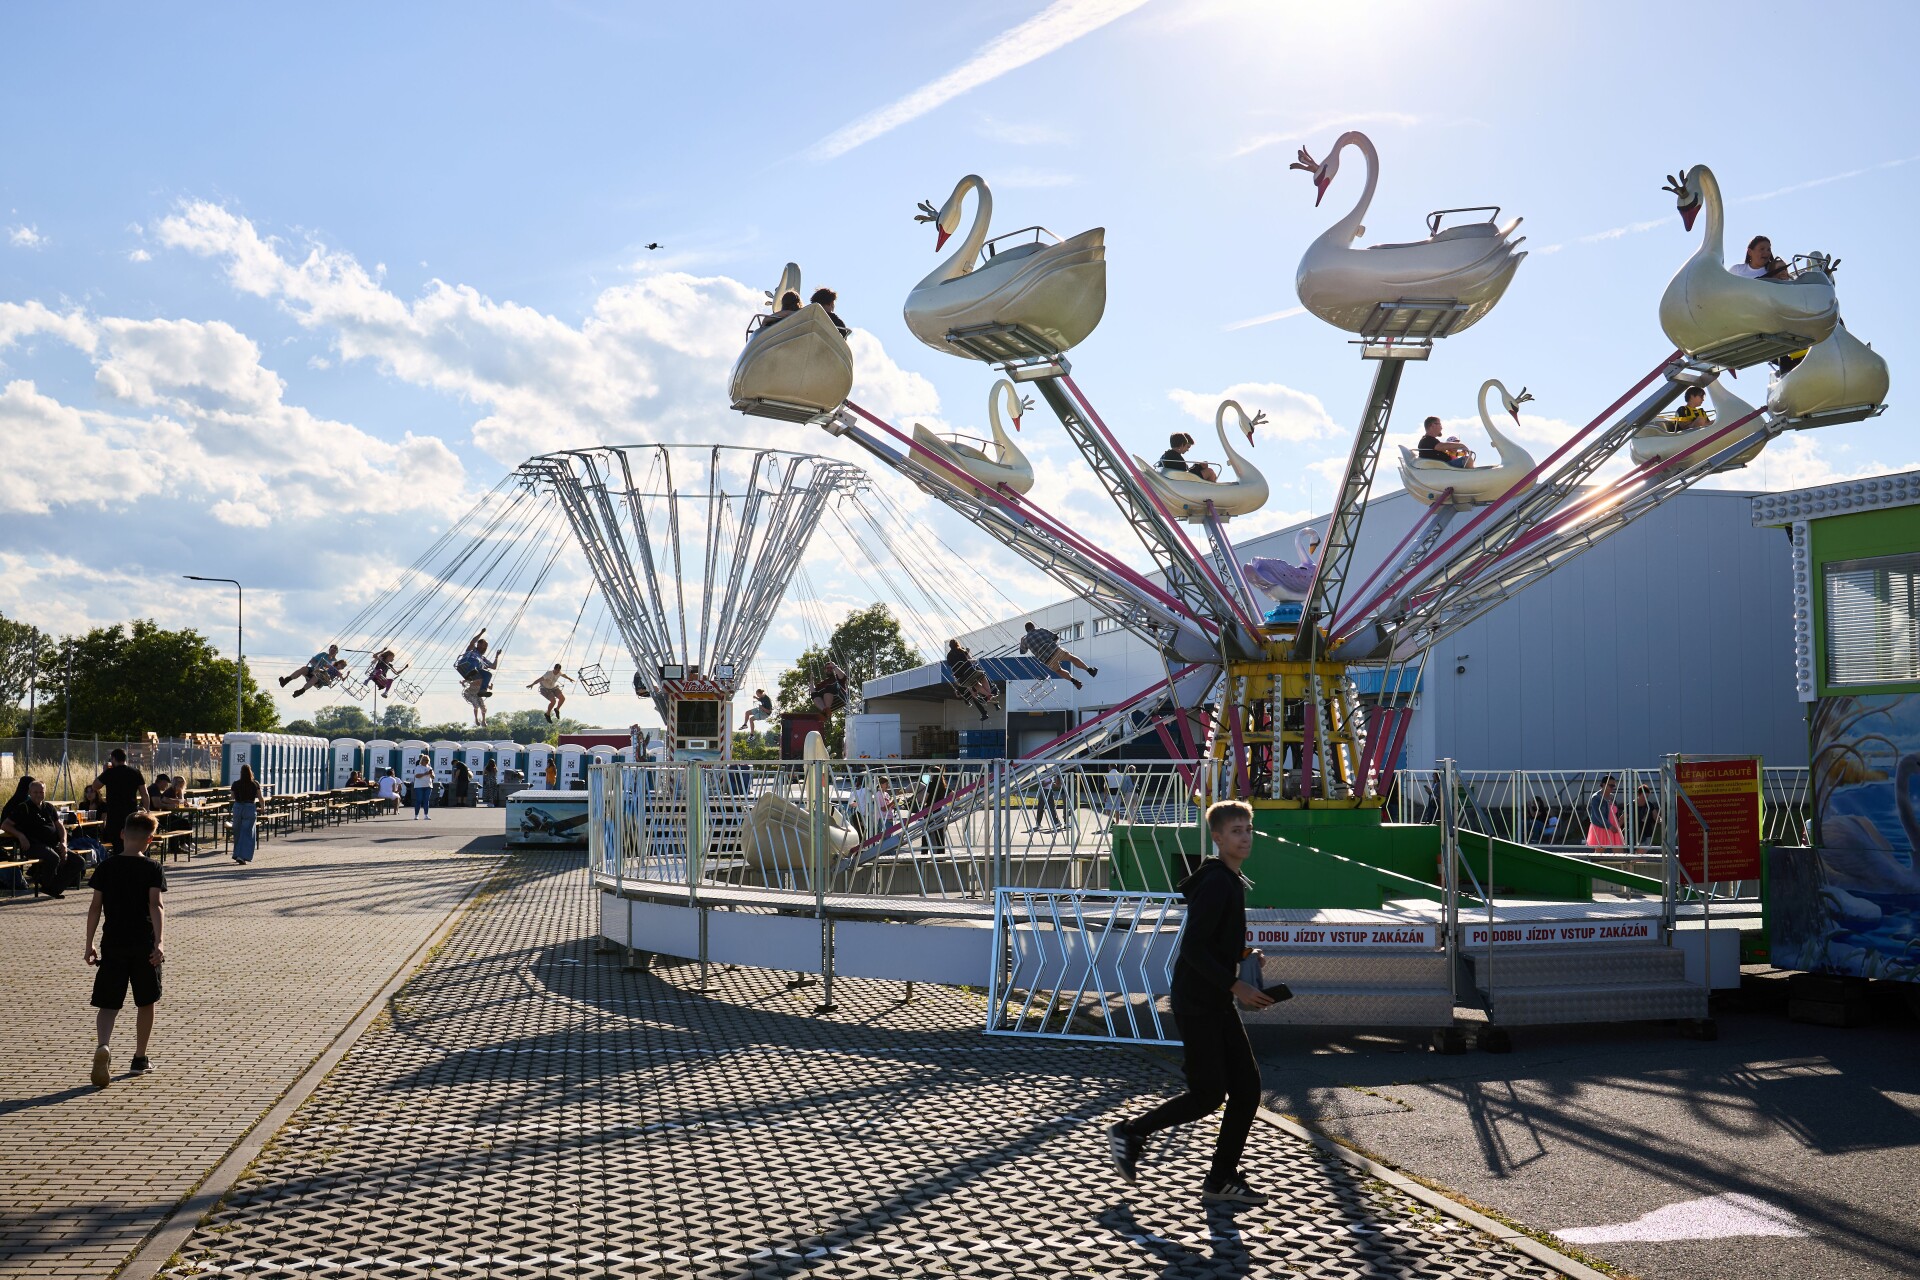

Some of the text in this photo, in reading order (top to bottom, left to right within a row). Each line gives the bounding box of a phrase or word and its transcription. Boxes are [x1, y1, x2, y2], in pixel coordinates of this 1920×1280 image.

[1718, 766, 1752, 776] LABUTĚ
[1246, 928, 1424, 943] O DOBU JÍZDY VSTUP ZAKÁZÁN
[1473, 923, 1648, 942] PO DOBU JÍZDY VSTUP ZAKÁZÁN
